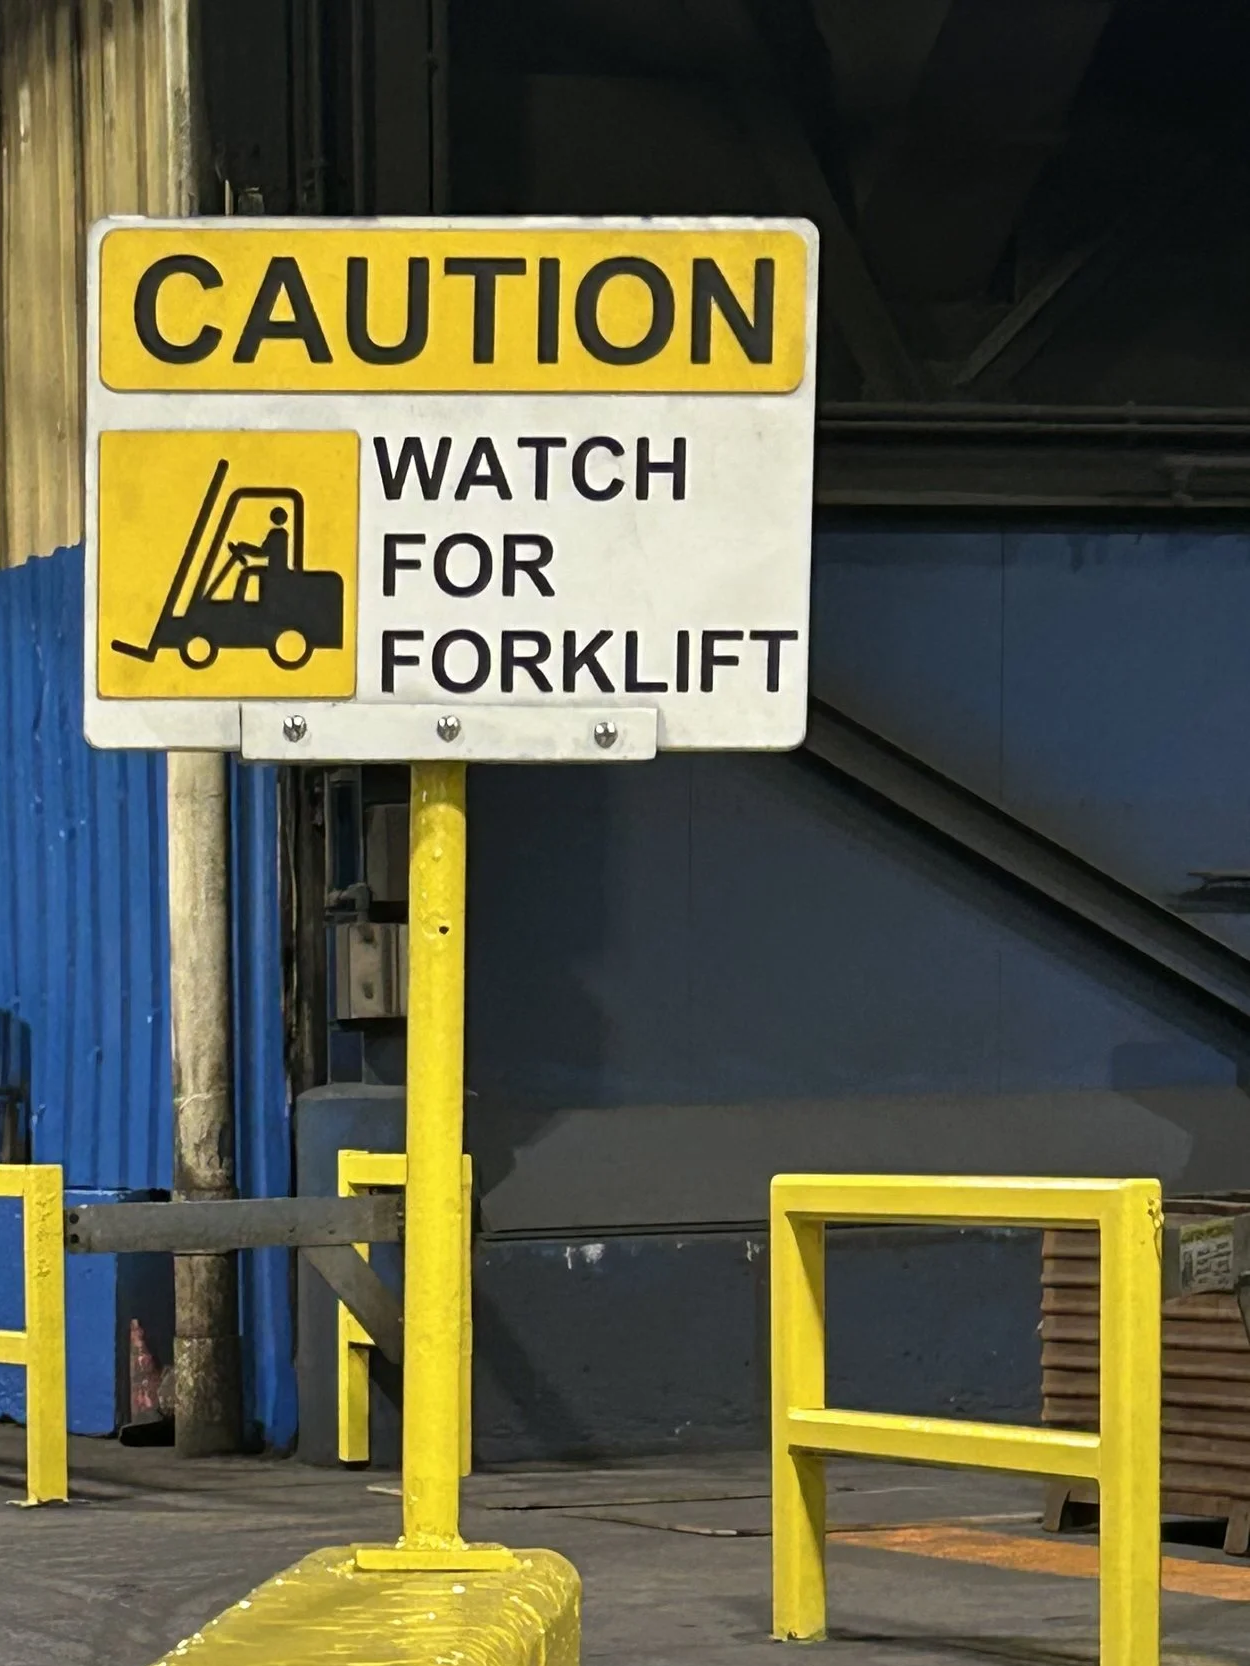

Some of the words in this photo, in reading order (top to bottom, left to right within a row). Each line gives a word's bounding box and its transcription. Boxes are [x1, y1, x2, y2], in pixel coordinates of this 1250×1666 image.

[133, 253, 776, 366] CAUTION
[374, 435, 688, 502] WATCH
[381, 532, 556, 597] FOR
[380, 628, 799, 694] FORKLIFT
